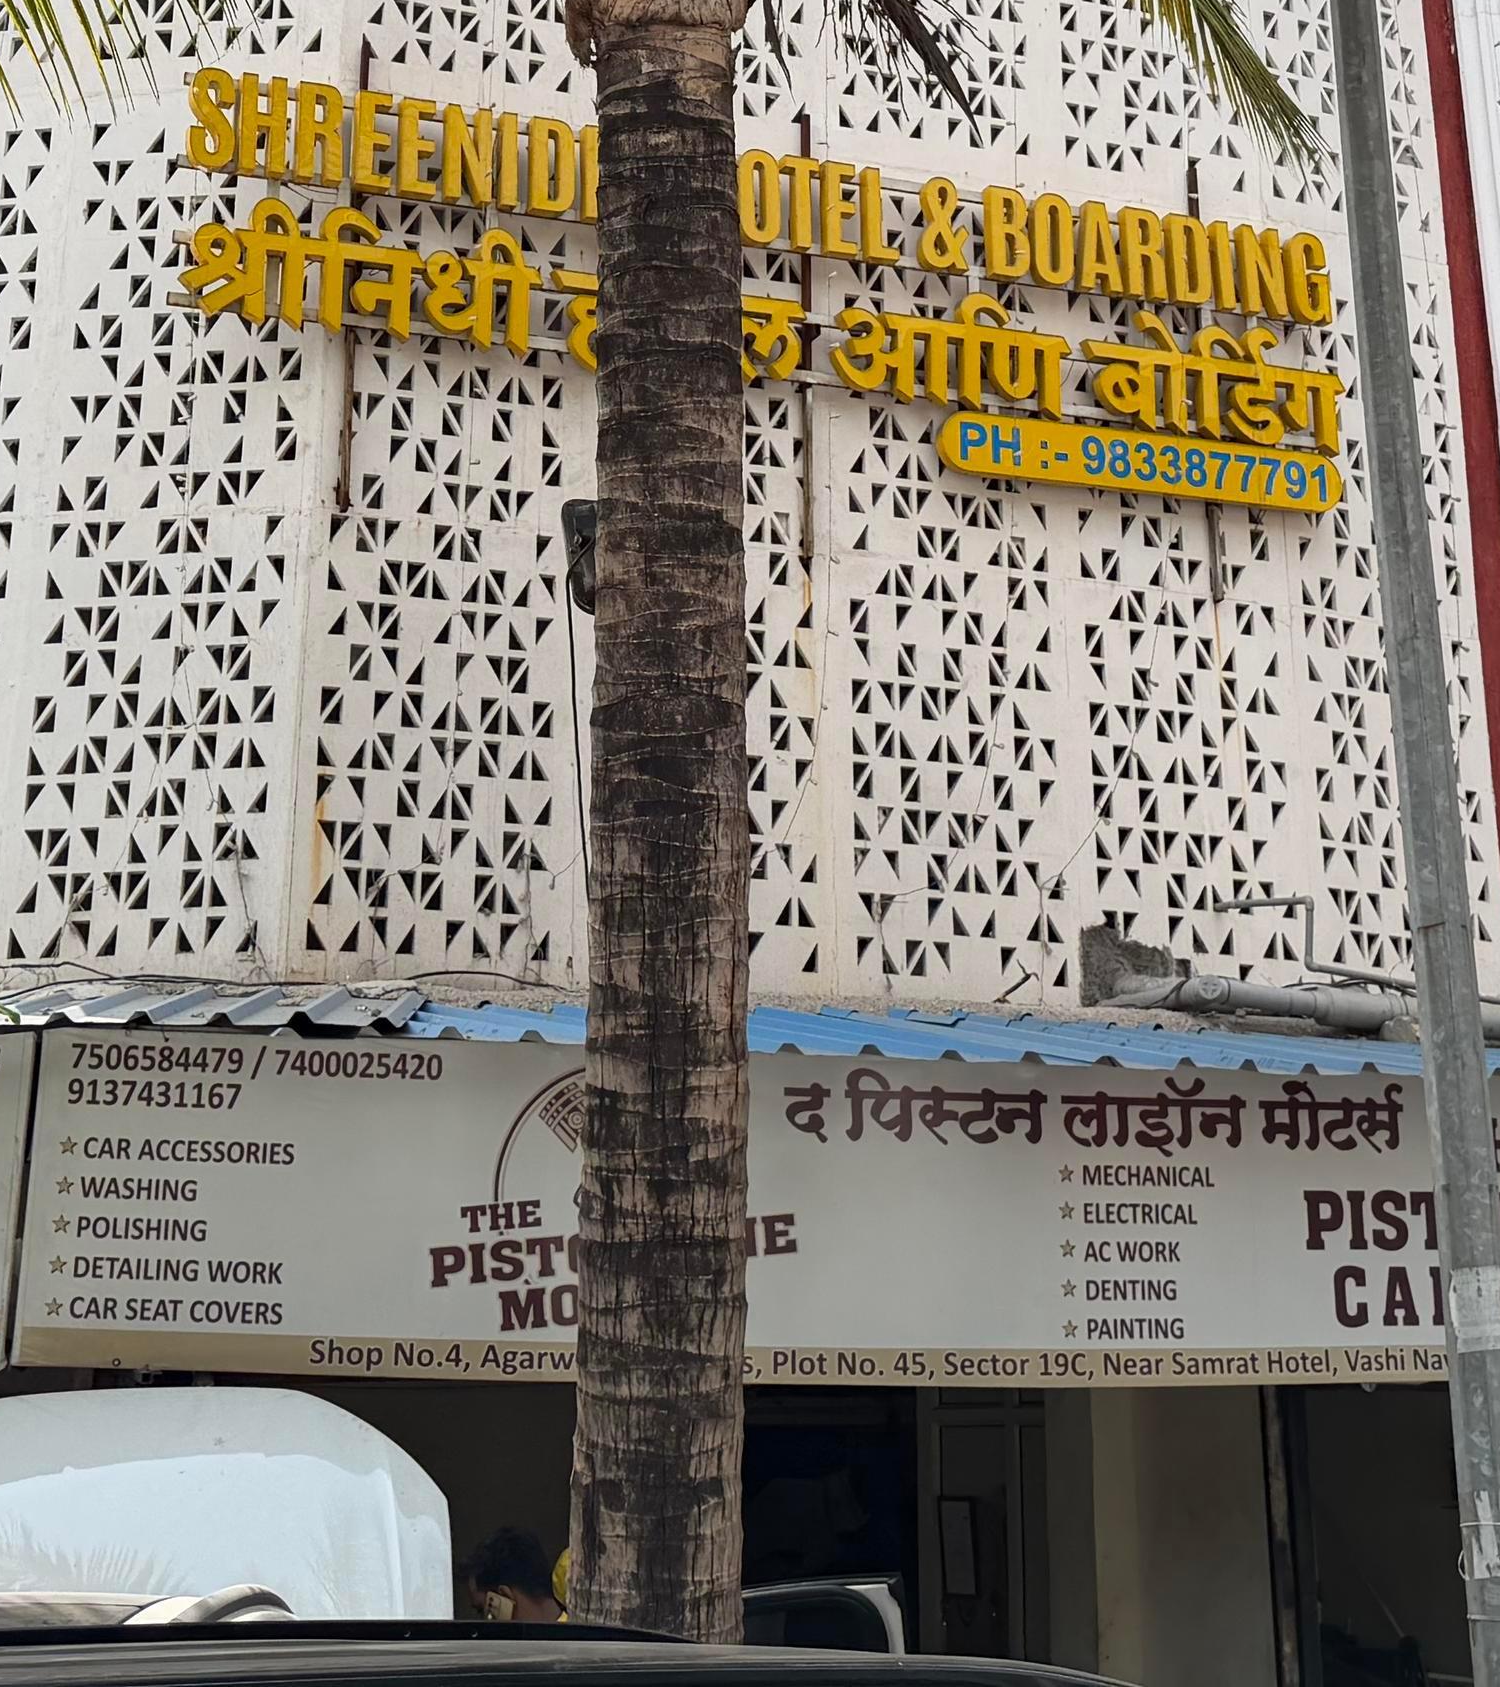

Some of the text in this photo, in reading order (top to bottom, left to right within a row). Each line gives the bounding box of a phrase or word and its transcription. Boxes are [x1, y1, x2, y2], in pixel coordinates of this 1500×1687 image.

[186, 66, 1333, 326] SHREENID OTEL & BOARDING
[179, 197, 543, 356] श्रीनिधी
[830, 292, 1072, 421] आणि
[959, 421, 1021, 467] PH
[1082, 434, 1328, 503] 9833877791
[71, 1043, 244, 1075] 7506584479
[274, 1049, 443, 1081] 7400025420
[67, 1078, 242, 1110] 9137431167
[784, 1083, 830, 1143] द
[845, 1069, 1047, 1145] पिस्टन
[83, 1136, 295, 1166] CAR ACCESSORIES
[80, 1176, 198, 1202] WASHING
[1082, 1165, 1215, 1188] MECHANICAL
[460, 1199, 542, 1233] THE
[1083, 1202, 1198, 1225] ELECTRICAL
[76, 1216, 208, 1242] POLISHING
[429, 1233, 579, 1288] PIST
[1084, 1241, 1181, 1263] AC WORK
[73, 1256, 283, 1286] DETAILING WORK
[1085, 1279, 1178, 1301] DENTING
[69, 1296, 283, 1326] CAR SEAT COVERS
[1086, 1318, 1185, 1340] PAINTING
[309, 1339, 383, 1371] Shop
[480, 1344, 575, 1375] Agarw
[772, 1349, 828, 1376] Plot
[837, 1351, 884, 1376] No.
[893, 1352, 935, 1380] 45,
[944, 1352, 1030, 1376] Sector
[1039, 1352, 1094, 1381] 19C,
[1103, 1352, 1164, 1375] Near
[1171, 1351, 1259, 1375] Samrat
[1266, 1350, 1338, 1376] Hotel,
[1344, 1348, 1406, 1372] Vashi
